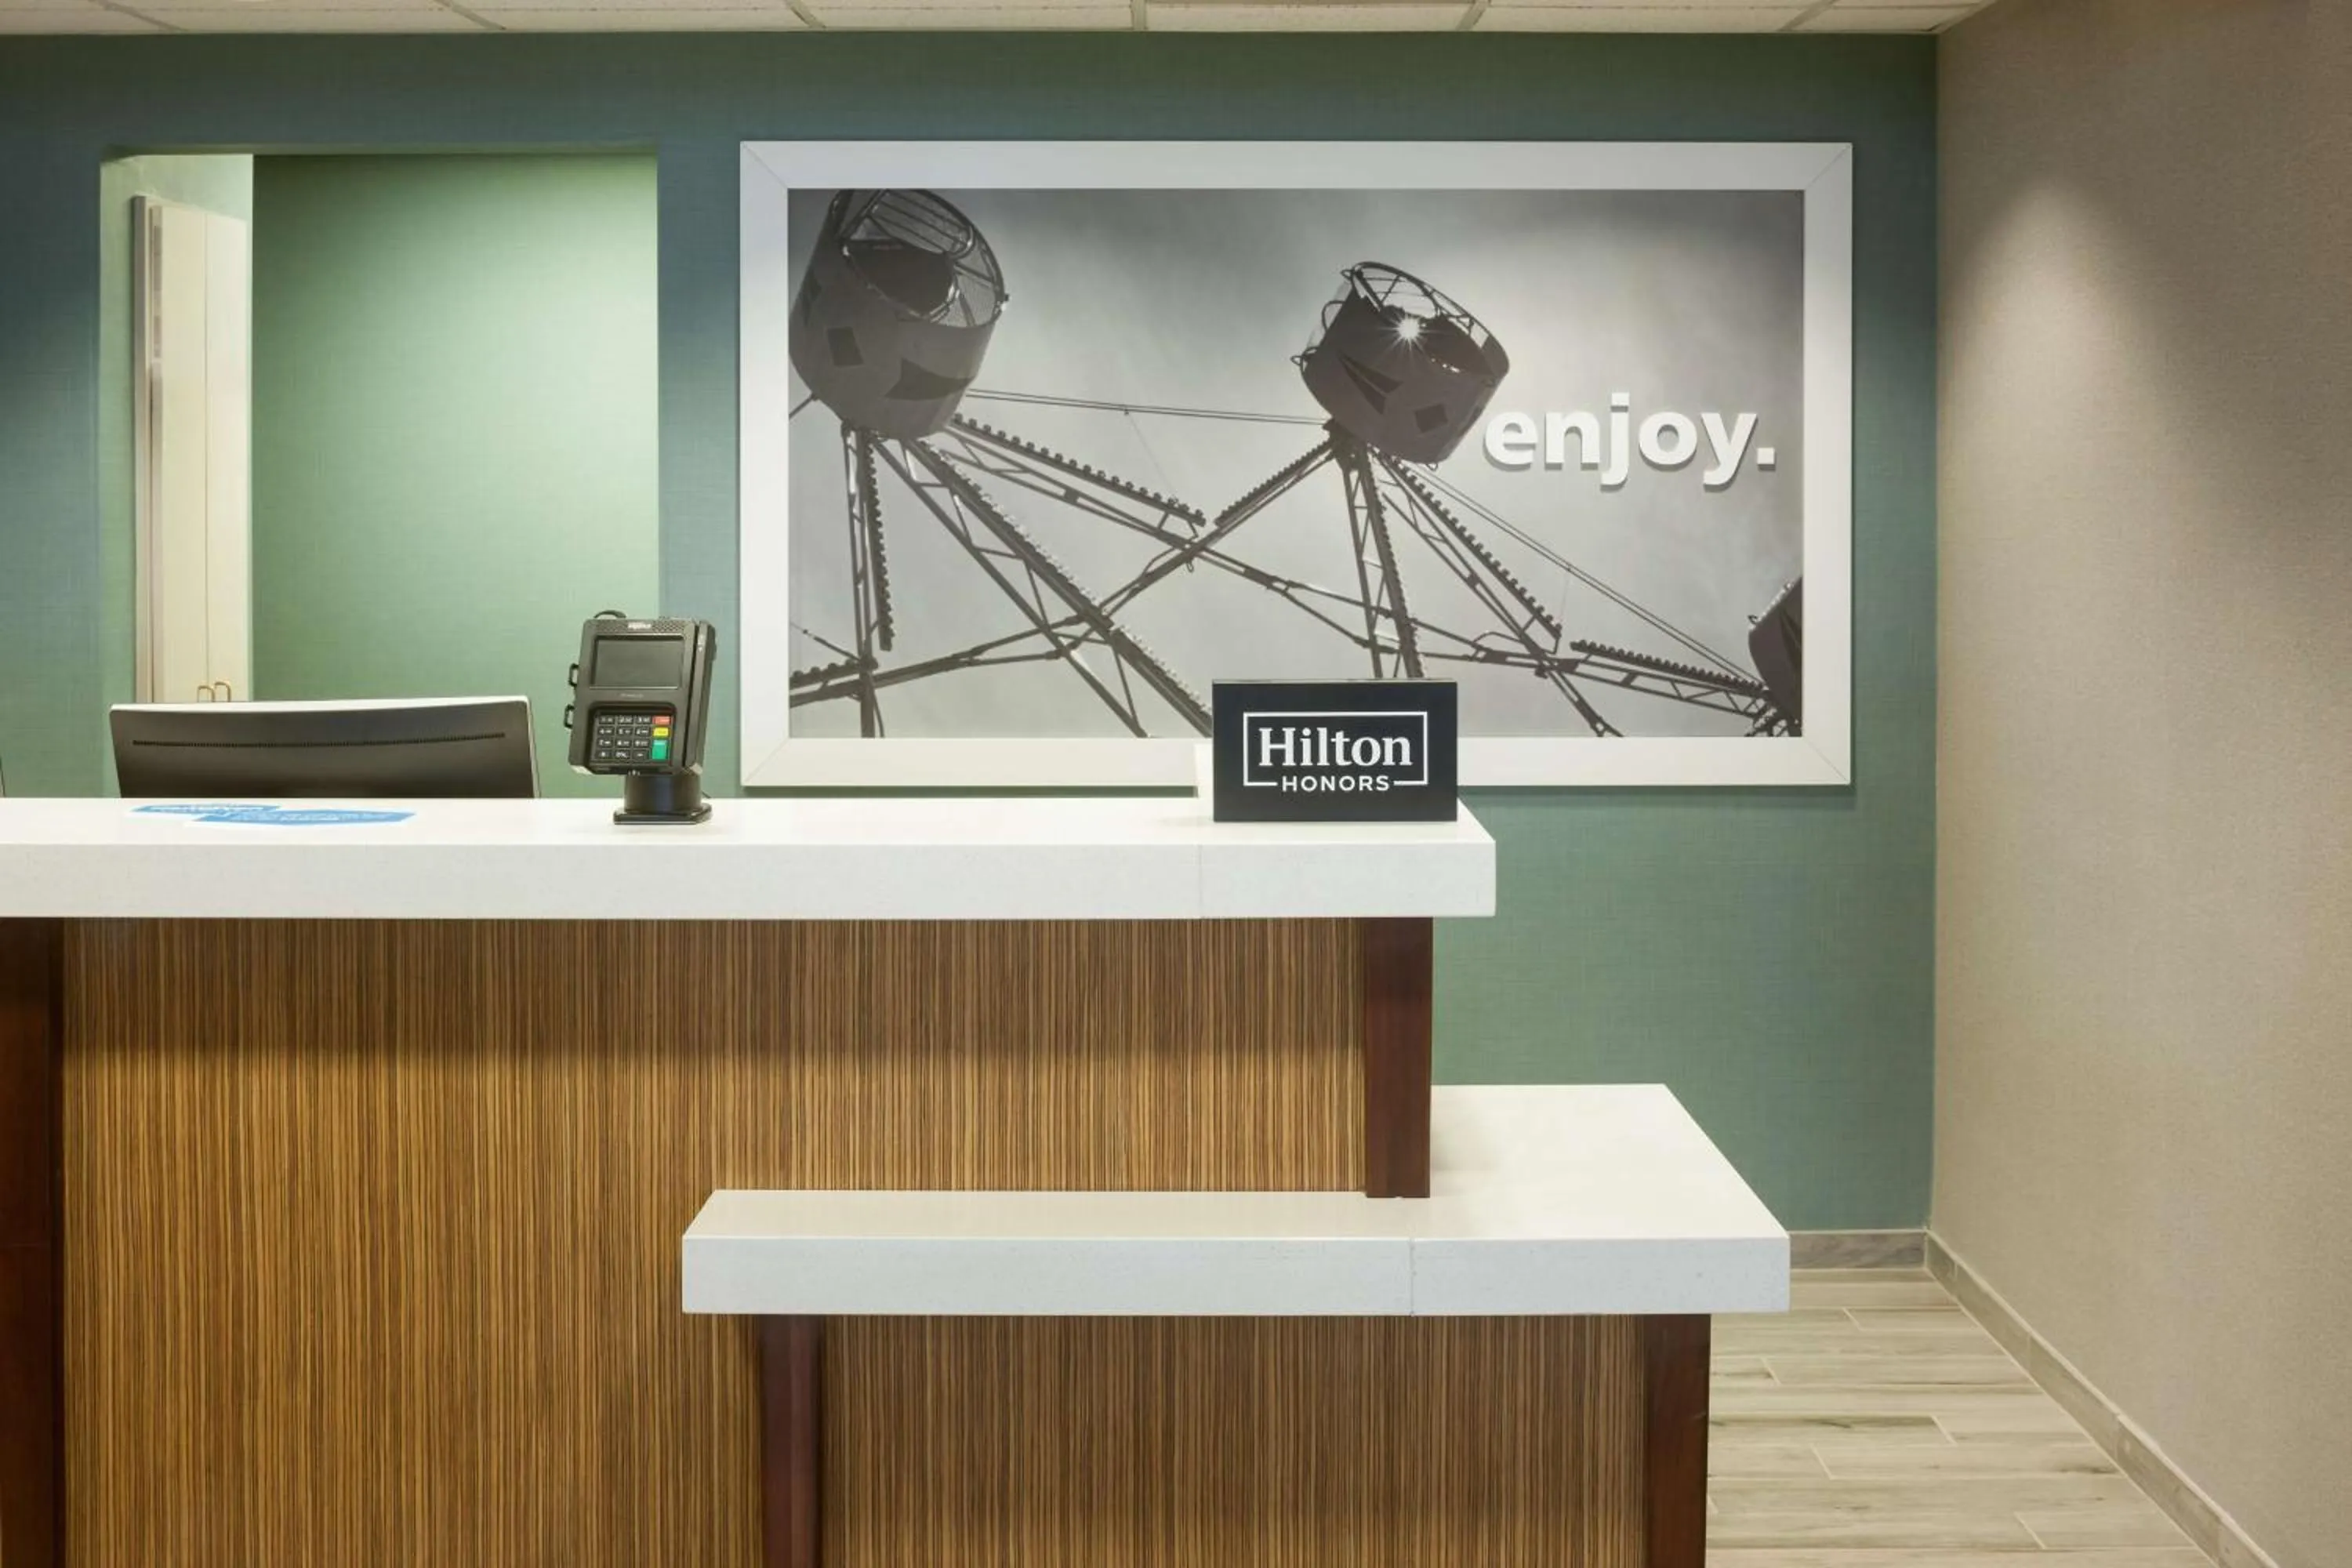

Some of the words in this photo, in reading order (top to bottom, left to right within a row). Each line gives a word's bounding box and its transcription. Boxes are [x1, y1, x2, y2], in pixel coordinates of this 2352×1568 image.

[1484, 392, 1776, 486] enjoy.
[1258, 727, 1413, 767] Hilton
[1282, 775, 1390, 793] HONORS
